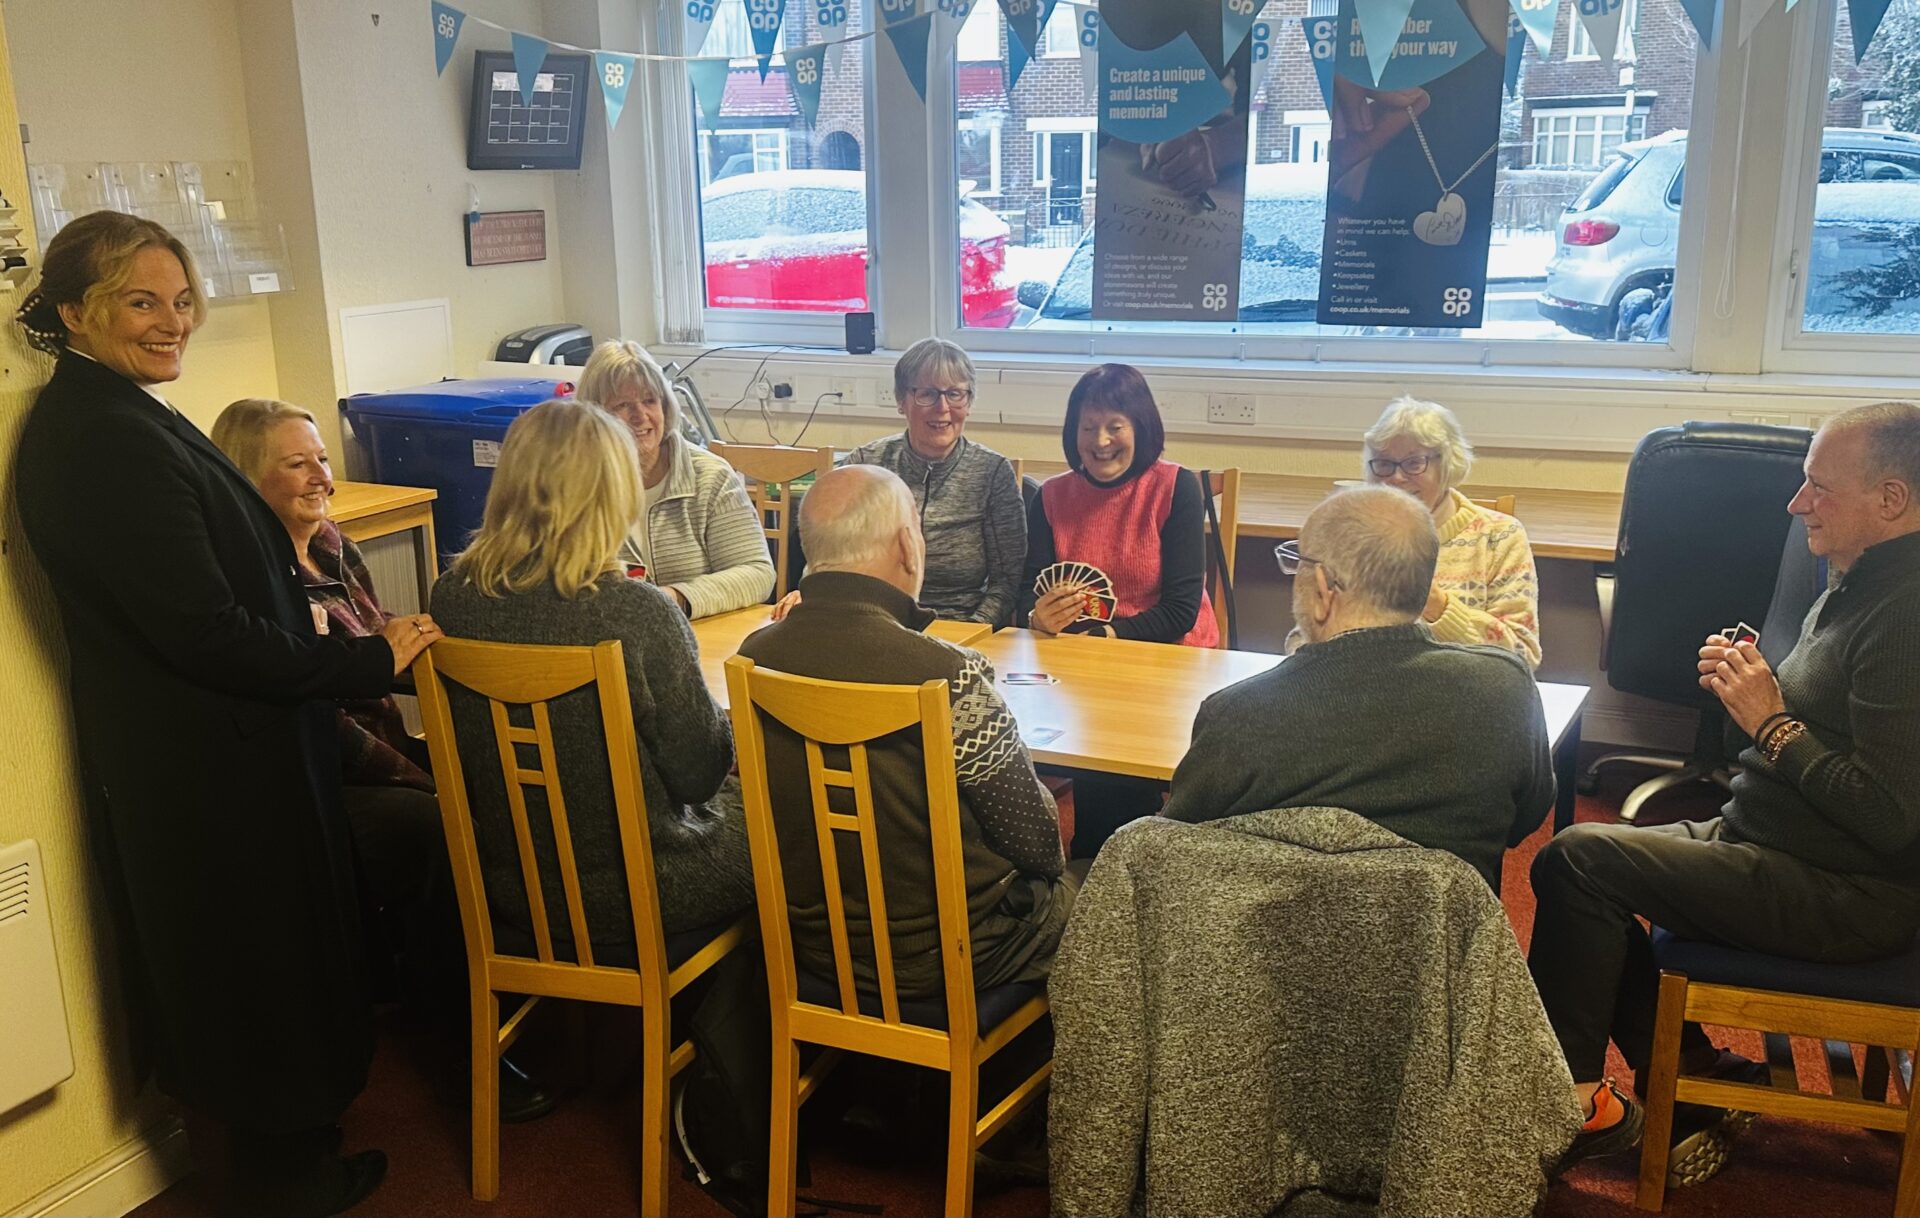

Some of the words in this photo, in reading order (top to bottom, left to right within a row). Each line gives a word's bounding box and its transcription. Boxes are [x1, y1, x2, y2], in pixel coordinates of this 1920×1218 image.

[1350, 17, 1433, 35] Rber
[1391, 41, 1426, 60] your
[1427, 41, 1458, 58] way
[1109, 67, 1151, 83] Create
[1152, 69, 1160, 82] a
[1162, 66, 1206, 84] unique
[1109, 85, 1132, 101] and
[1134, 85, 1178, 103] lasting
[1109, 103, 1168, 119] memorial
[1203, 283, 1228, 296] co
[1443, 287, 1473, 301] co
[1202, 296, 1227, 312] op
[1442, 300, 1471, 317] op
